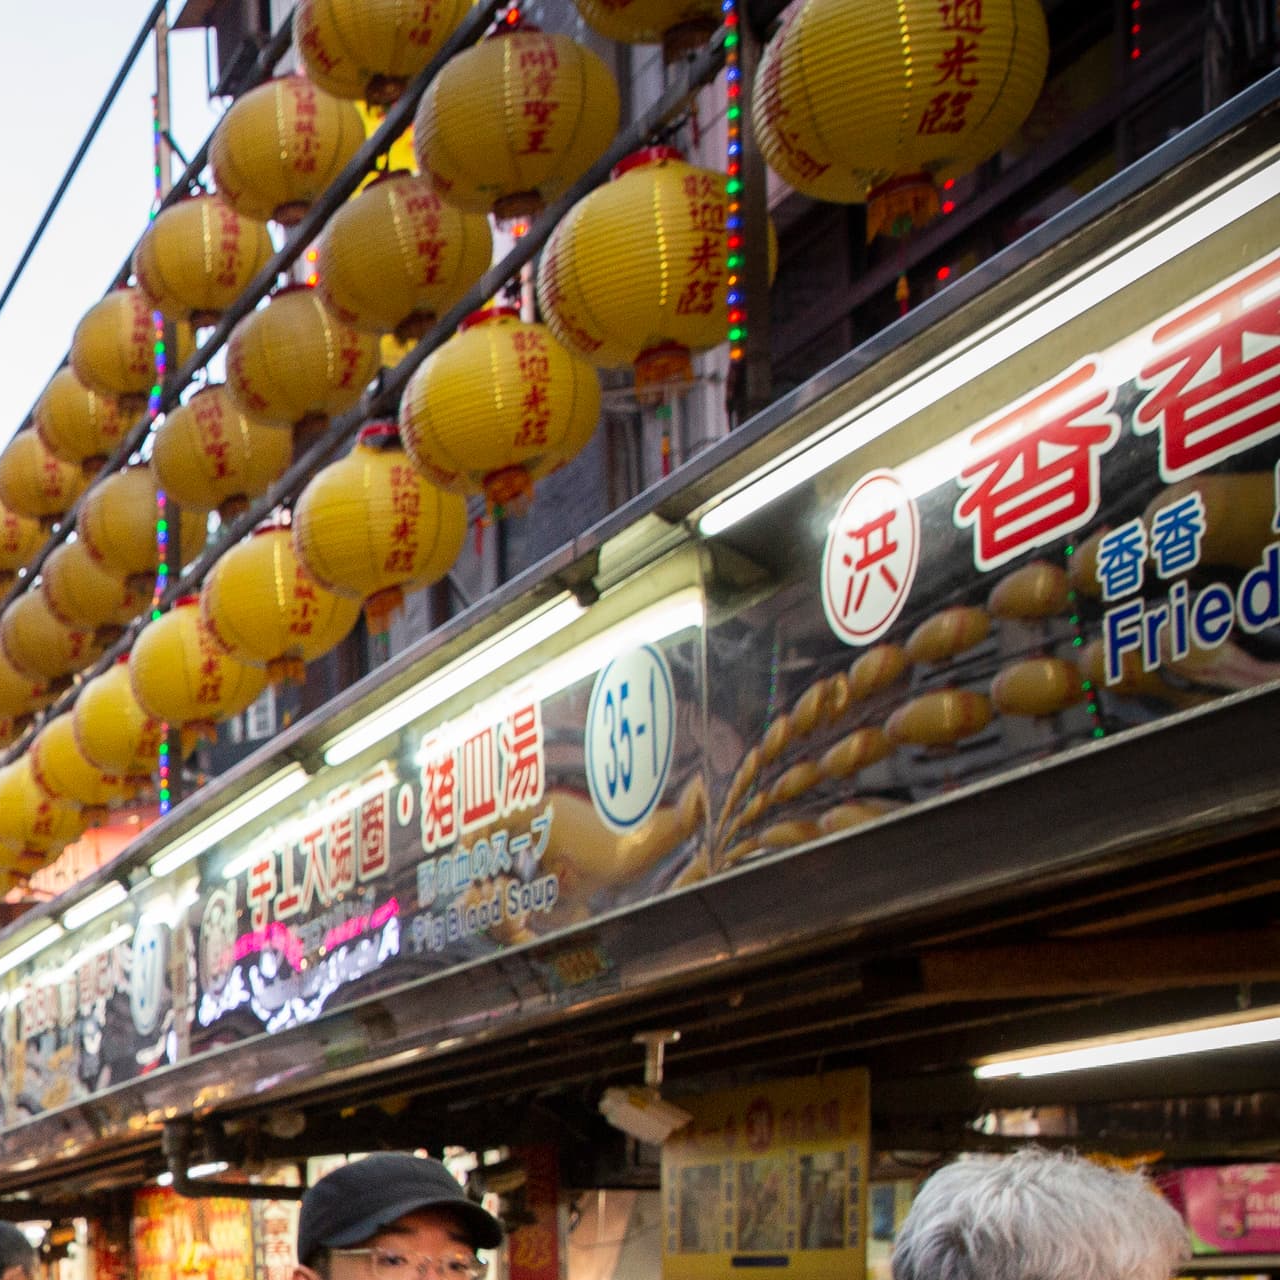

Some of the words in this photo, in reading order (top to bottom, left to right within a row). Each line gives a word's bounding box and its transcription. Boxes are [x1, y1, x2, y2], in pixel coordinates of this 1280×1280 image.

[960, 256, 1280, 562] 香香
[842, 510, 899, 618] 洪
[1099, 496, 1203, 599] 香香
[1106, 546, 1280, 683] Fried
[603, 666, 661, 799] 35-1
[506, 873, 559, 923] Soup
